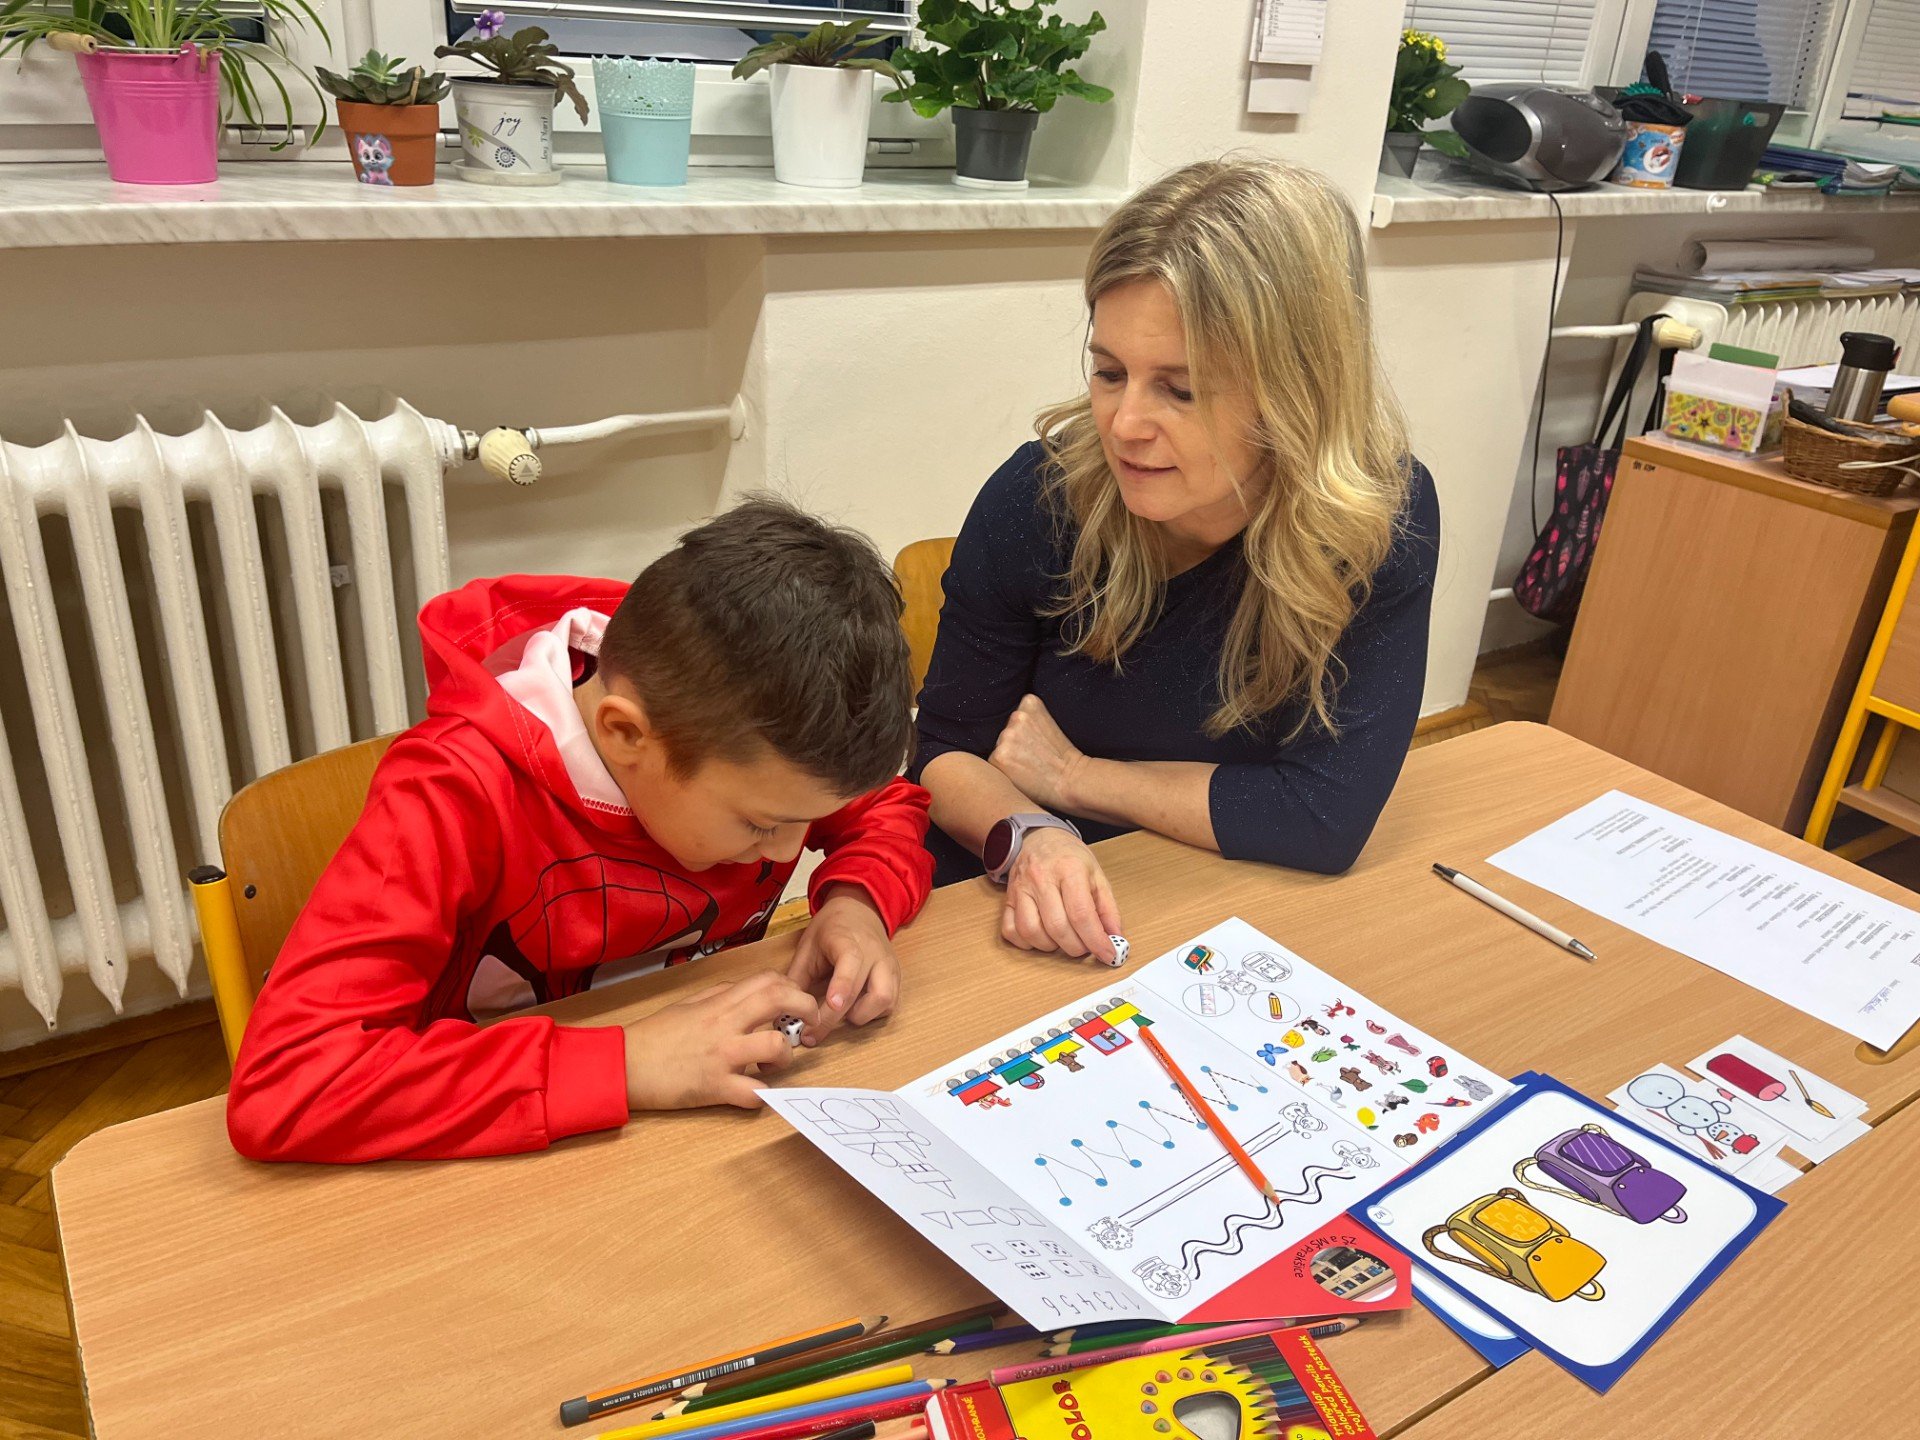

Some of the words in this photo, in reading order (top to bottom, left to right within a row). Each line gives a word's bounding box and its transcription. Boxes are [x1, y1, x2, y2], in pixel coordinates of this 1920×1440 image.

[492, 112, 521, 137] joy
[1310, 1237, 1329, 1250] MŠ
[1330, 1235, 1337, 1243] a
[1341, 1235, 1357, 1246] ZŠ
[1293, 1244, 1314, 1279] Prakšice
[1299, 1335, 1329, 1371] pastelek
[1305, 1364, 1331, 1393] pencils
[1052, 1380, 1092, 1440] OLOR
[1311, 1391, 1344, 1436] triangular
[1323, 1396, 1356, 1435] coloured
[1324, 1374, 1366, 1432] trojhranných
